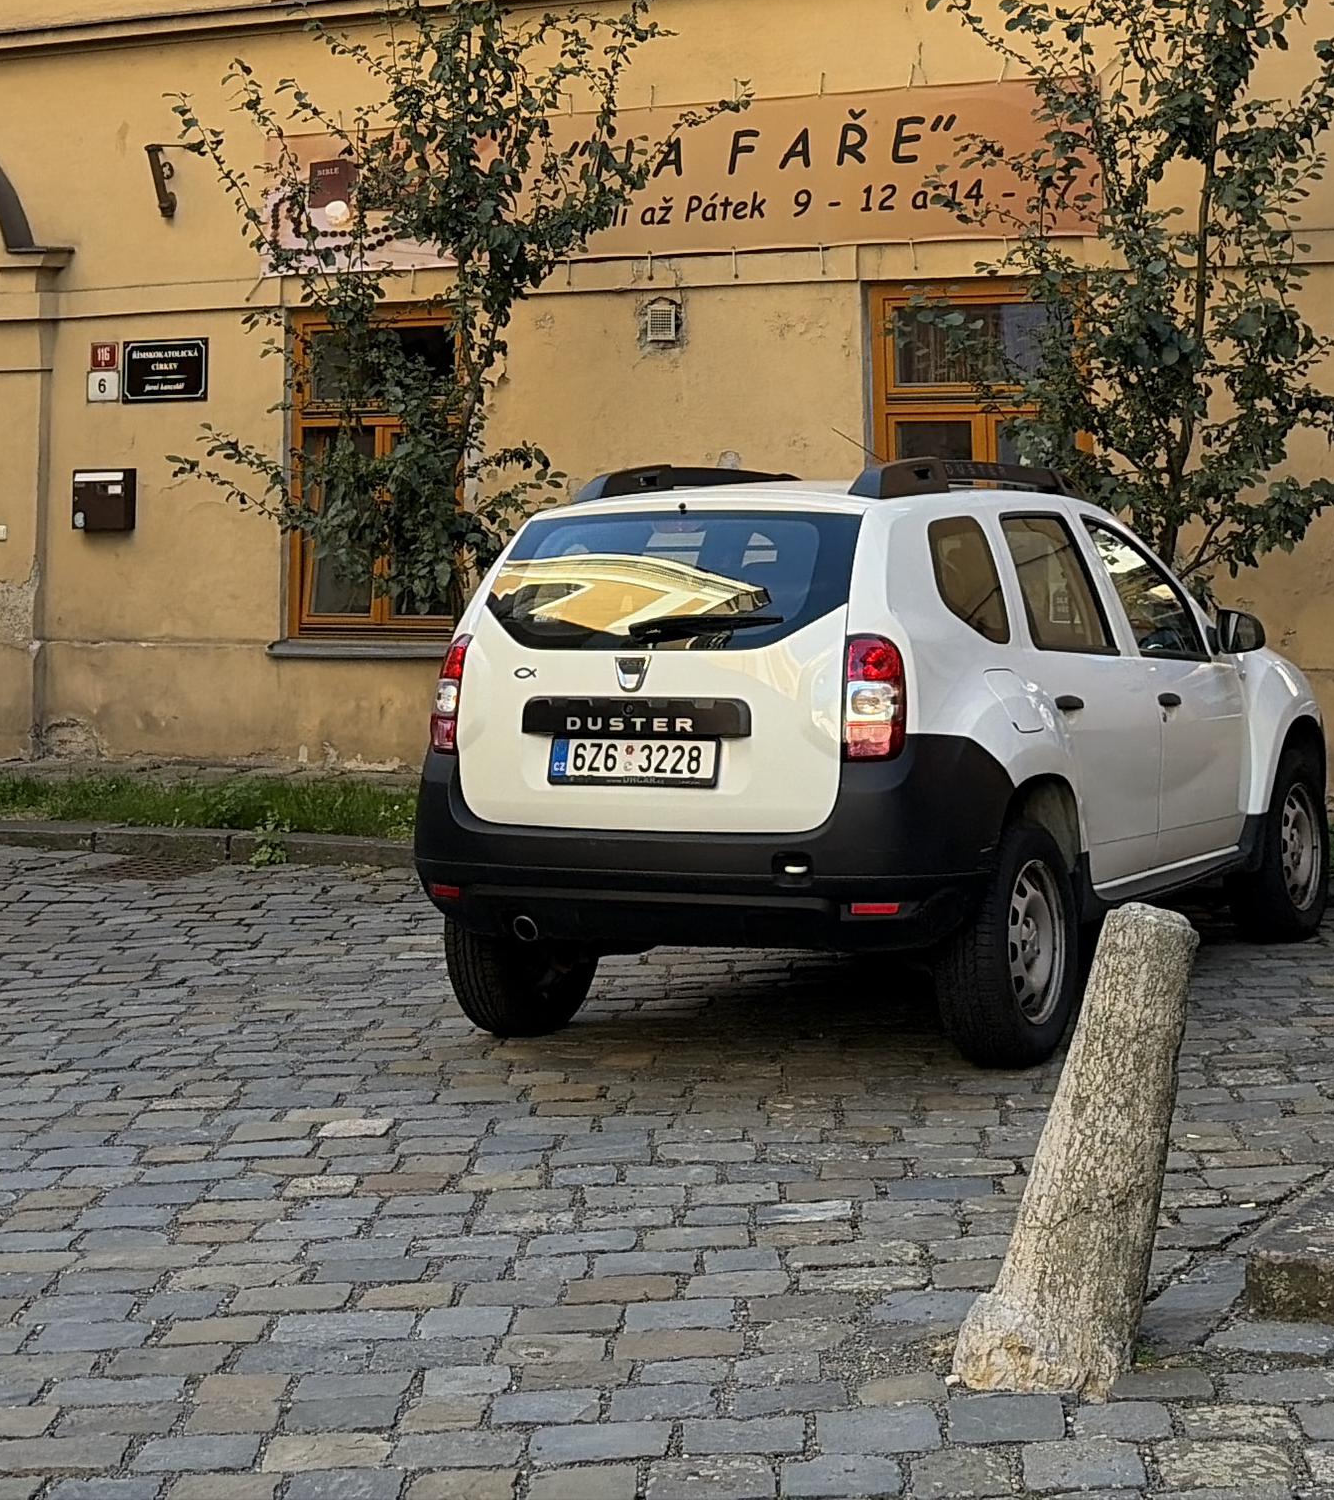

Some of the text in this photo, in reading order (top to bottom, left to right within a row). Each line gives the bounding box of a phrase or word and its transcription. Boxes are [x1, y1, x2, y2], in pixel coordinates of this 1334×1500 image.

[727, 108, 957, 176] FAŘE"
[317, 167, 340, 176] BIBLE
[640, 196, 674, 226] až
[684, 191, 767, 223] Pátek
[793, 189, 812, 217] 9
[860, 183, 898, 212] 12
[911, 190, 929, 210] a
[948, 178, 984, 206] 14
[97, 347, 110, 361] 116
[98, 378, 107, 393] 6
[567, 717, 694, 732] DUSTER
[572, 743, 702, 774] 6Z6 3228
[553, 761, 566, 772] CZ
